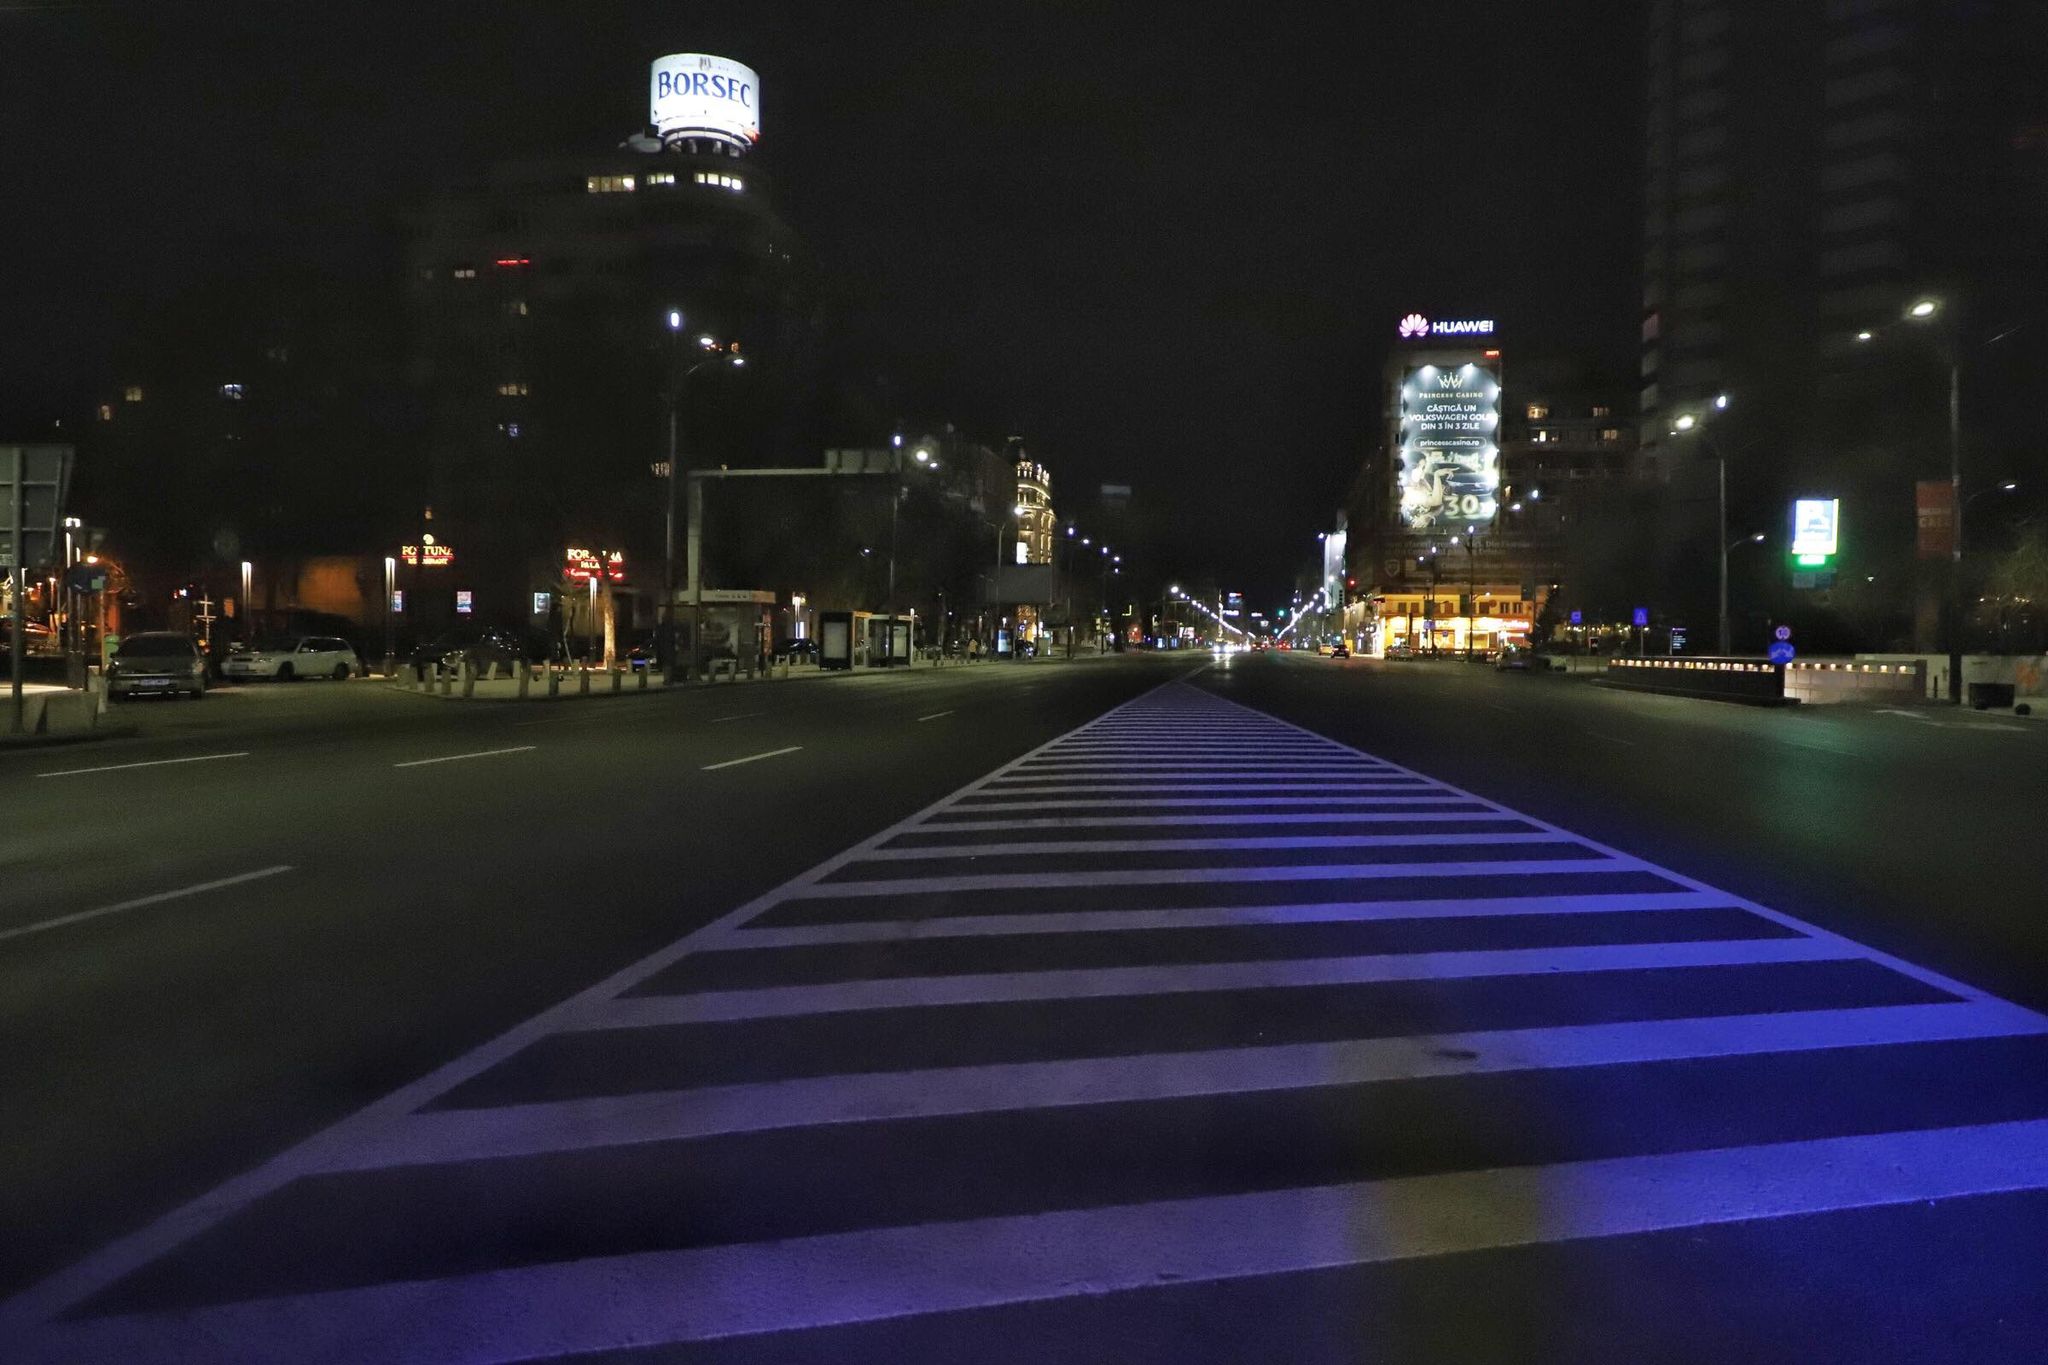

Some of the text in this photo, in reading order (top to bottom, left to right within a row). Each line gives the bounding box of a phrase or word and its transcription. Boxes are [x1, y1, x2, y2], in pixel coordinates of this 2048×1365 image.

[658, 71, 751, 108] BORSEC
[1432, 320, 1494, 333] HUAWEI
[1464, 404, 1477, 412] UN
[1410, 413, 1468, 421] VOLKSWAGEN
[1444, 421, 1454, 430] ÎN
[1462, 422, 1480, 430] ZILE
